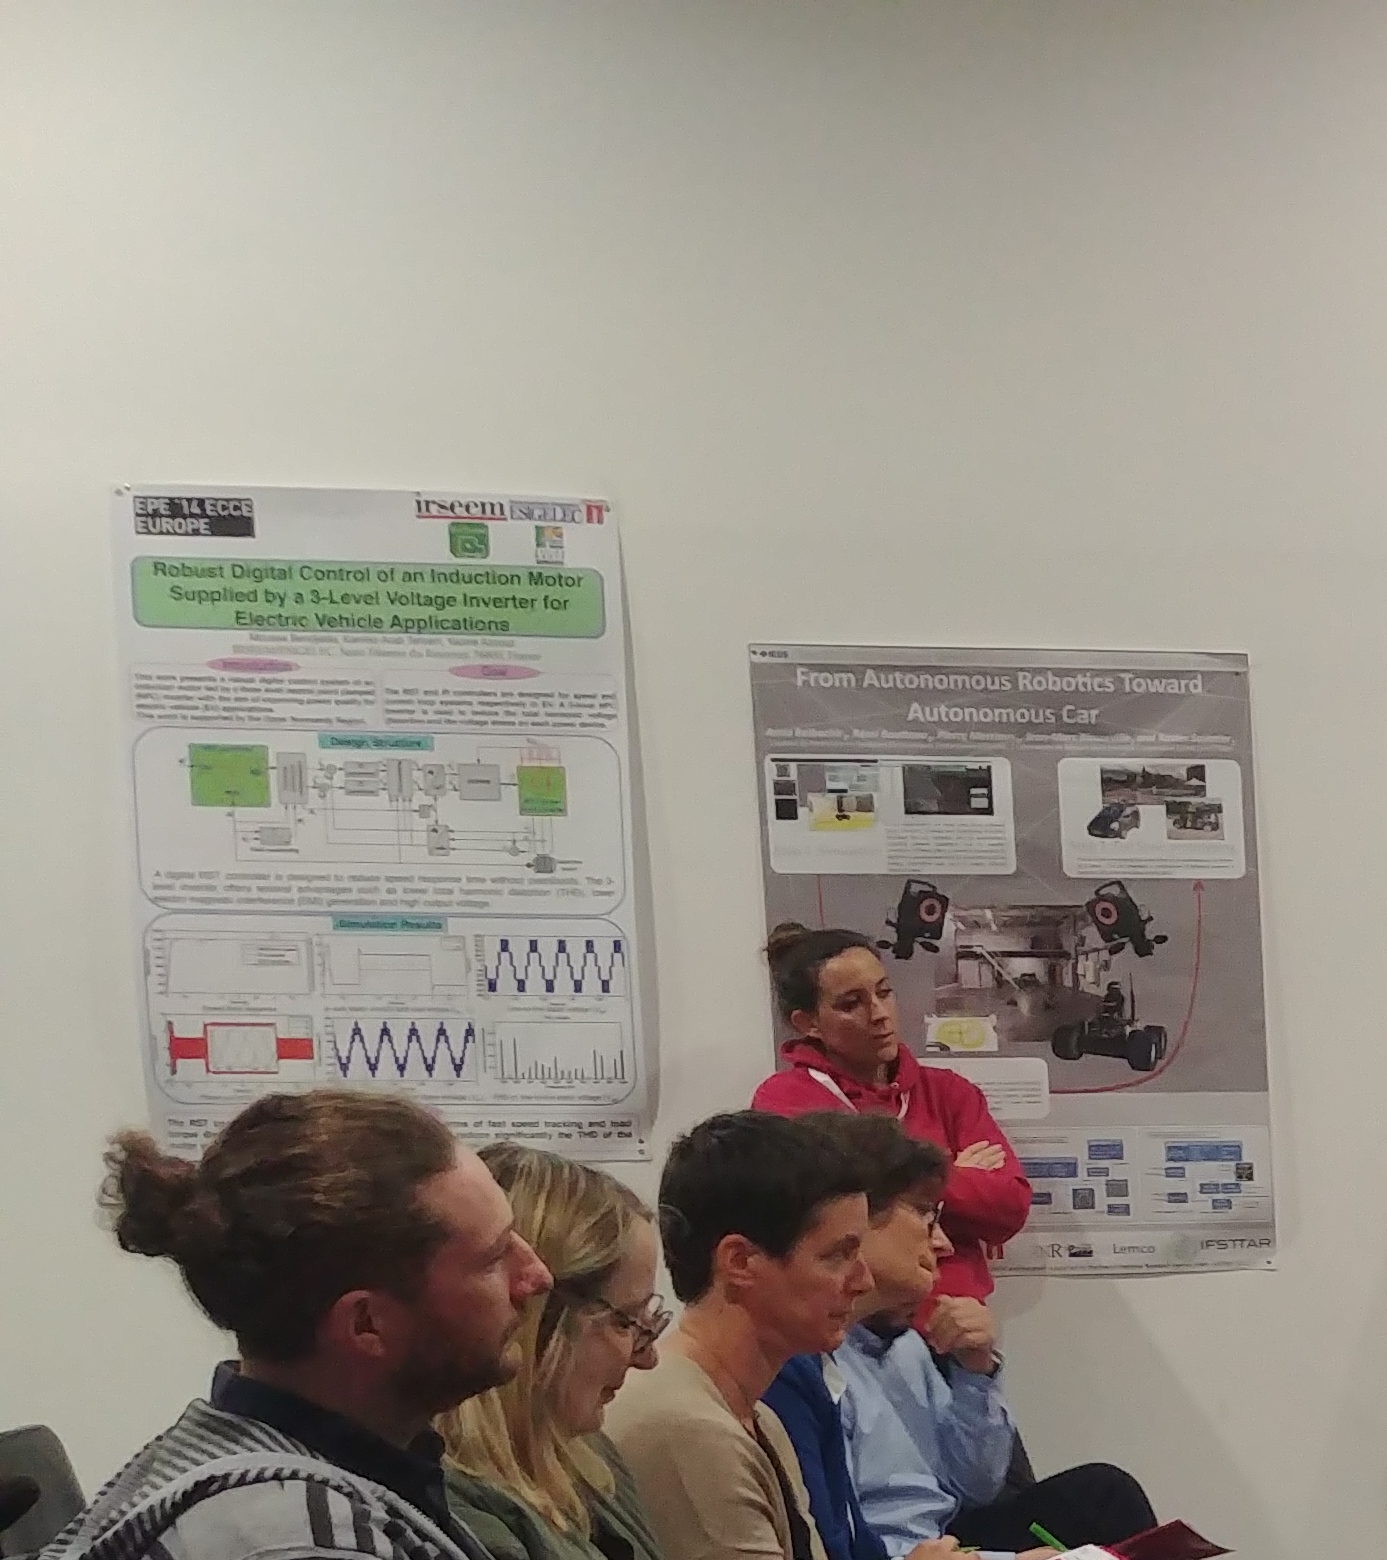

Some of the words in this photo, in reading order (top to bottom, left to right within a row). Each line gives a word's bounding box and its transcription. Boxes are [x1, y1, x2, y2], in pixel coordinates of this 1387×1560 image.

[134, 497, 171, 515] EPE
[204, 498, 252, 517] ECCE
[136, 517, 212, 535] EUROPE
[153, 562, 224, 579] Robust
[231, 563, 294, 583] Digital
[299, 565, 371, 582] Control
[377, 567, 395, 582] of
[401, 570, 425, 583] an
[430, 568, 522, 587] Induction
[528, 571, 584, 588] Motor
[169, 585, 258, 605] Supplied
[264, 588, 286, 608] by
[294, 592, 305, 604] a
[309, 589, 380, 606] 3-Level
[386, 590, 457, 611] Voltage
[462, 592, 538, 610] Inverter
[543, 594, 570, 611] for
[234, 609, 309, 627] Electric
[313, 612, 384, 629] Vehicle
[389, 614, 510, 632] Applications
[796, 668, 856, 688] From
[862, 669, 1011, 691] Autonomous
[1018, 672, 1114, 693] Robotics
[1118, 673, 1203, 694] Toward
[907, 702, 1056, 723] Autonomous
[1062, 704, 1100, 725] Car
